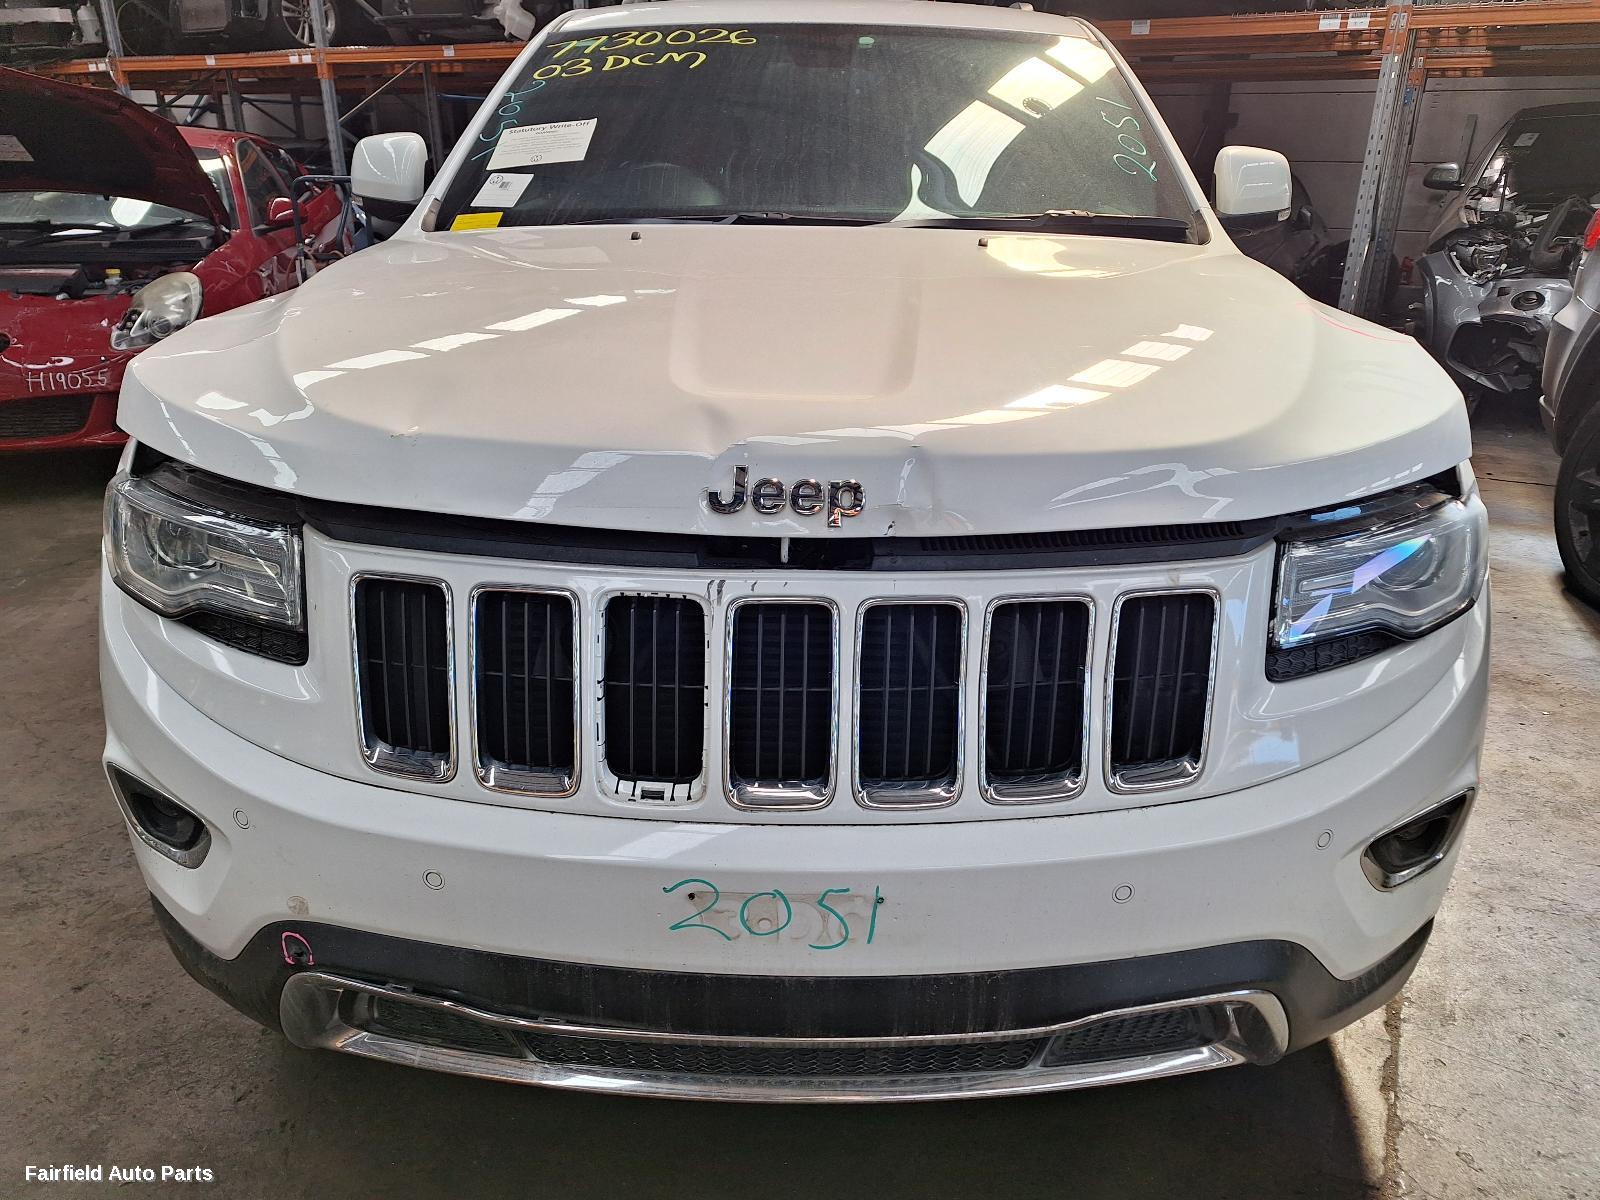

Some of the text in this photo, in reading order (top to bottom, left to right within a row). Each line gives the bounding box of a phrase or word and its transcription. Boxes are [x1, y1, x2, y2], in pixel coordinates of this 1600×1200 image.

[546, 28, 757, 59] 7730026
[601, 52, 707, 71] DCM
[508, 125, 547, 135] Statutory
[549, 121, 591, 130] Write-Off
[1095, 96, 1158, 182] 2051
[25, 367, 109, 393] H19055
[708, 464, 866, 528] Jeep
[662, 878, 880, 950] 2051
